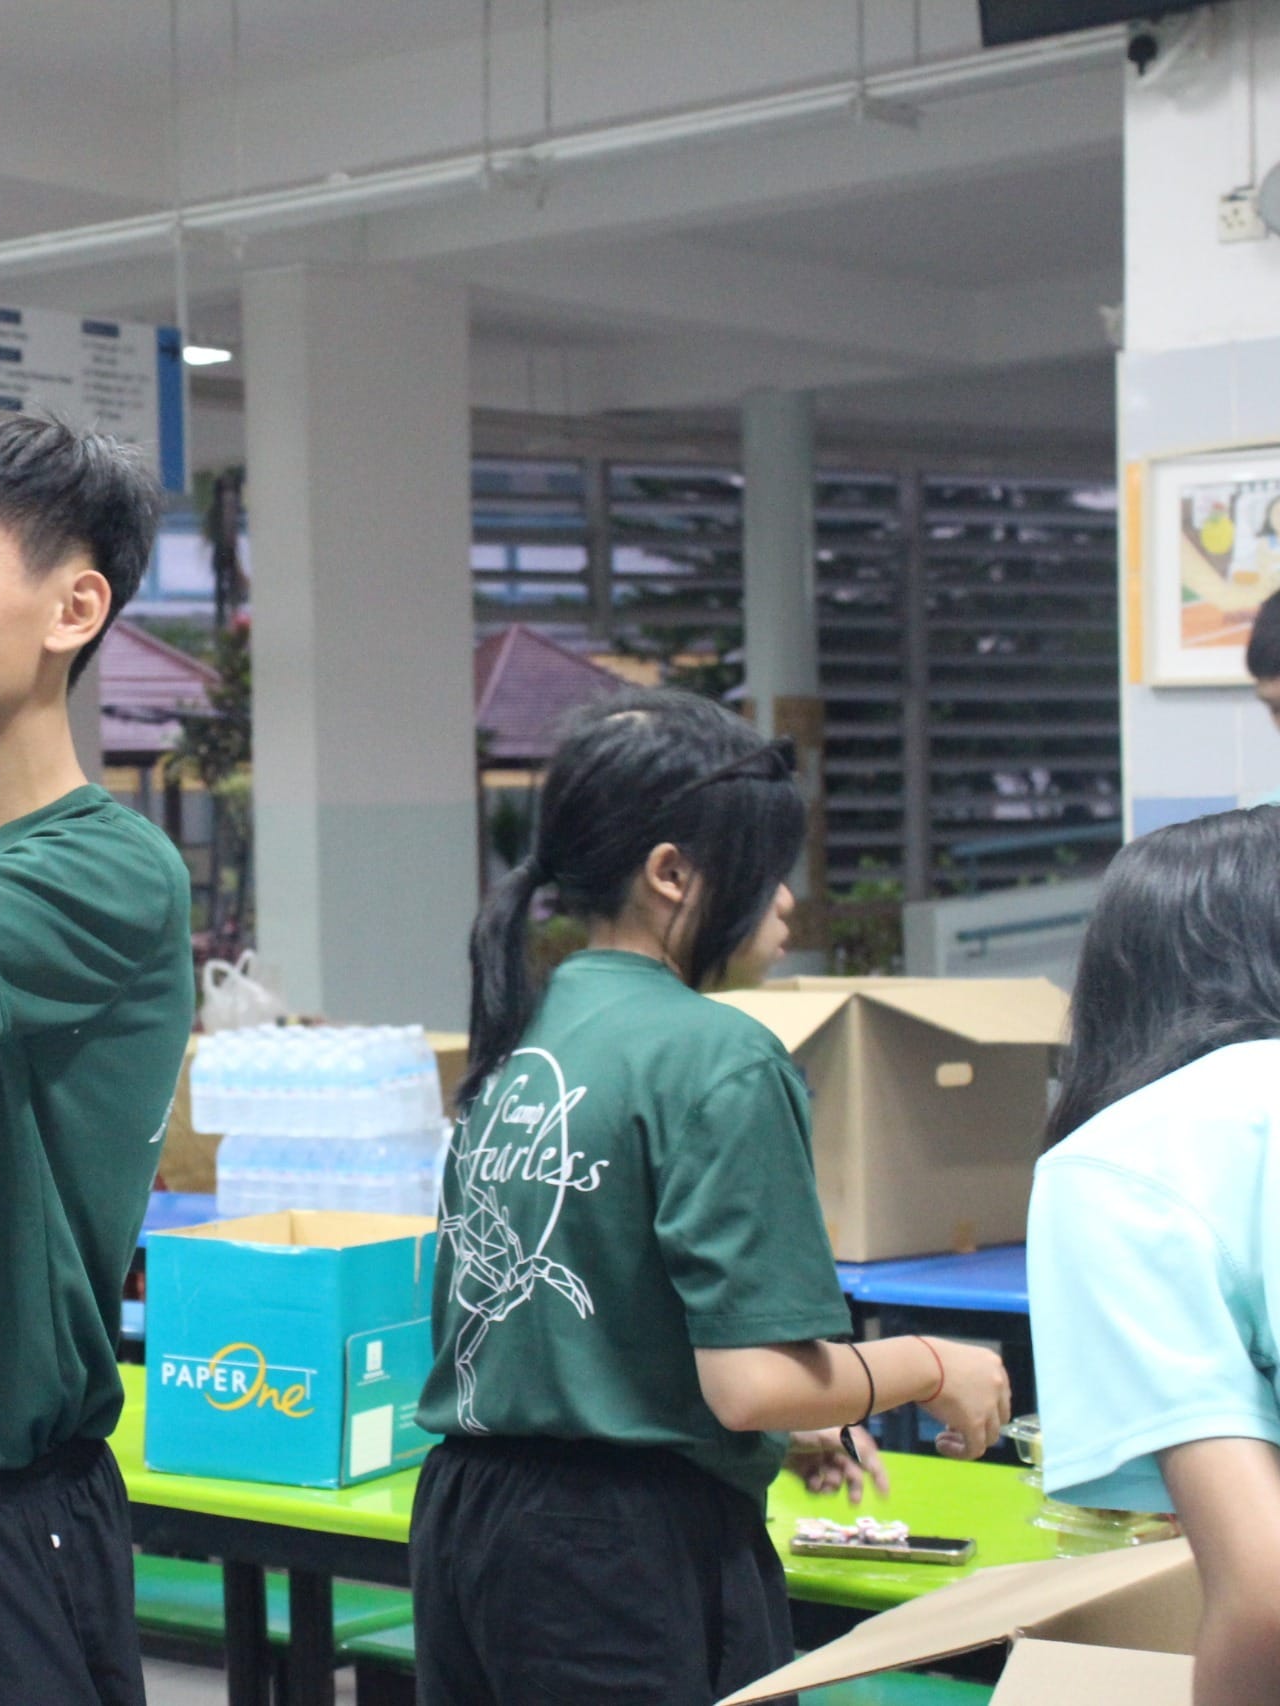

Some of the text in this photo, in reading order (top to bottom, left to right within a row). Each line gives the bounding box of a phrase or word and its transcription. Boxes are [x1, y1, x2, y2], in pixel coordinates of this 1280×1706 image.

[502, 1094, 546, 1134] Camp
[161, 1342, 315, 1418] PAPER One
